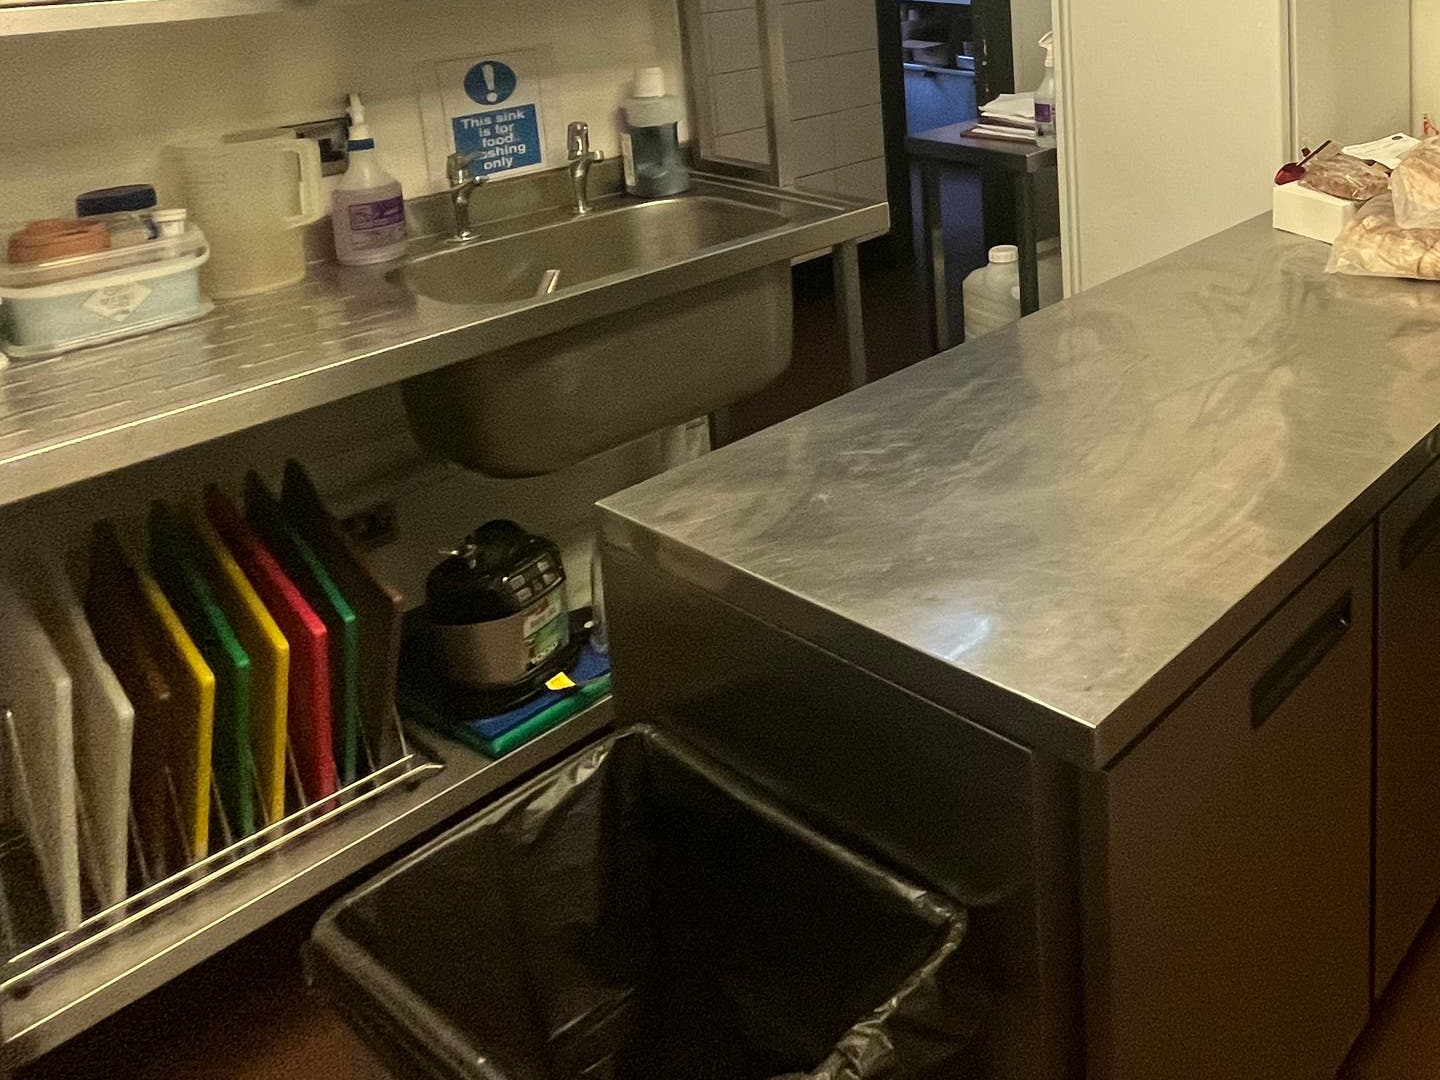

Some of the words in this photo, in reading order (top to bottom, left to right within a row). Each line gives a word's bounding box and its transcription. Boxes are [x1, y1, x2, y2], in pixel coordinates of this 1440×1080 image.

[461, 116, 492, 130] This
[495, 109, 526, 124] sink
[479, 127, 491, 138] is
[494, 123, 515, 134] for
[482, 132, 514, 148] food
[483, 156, 514, 170] only
